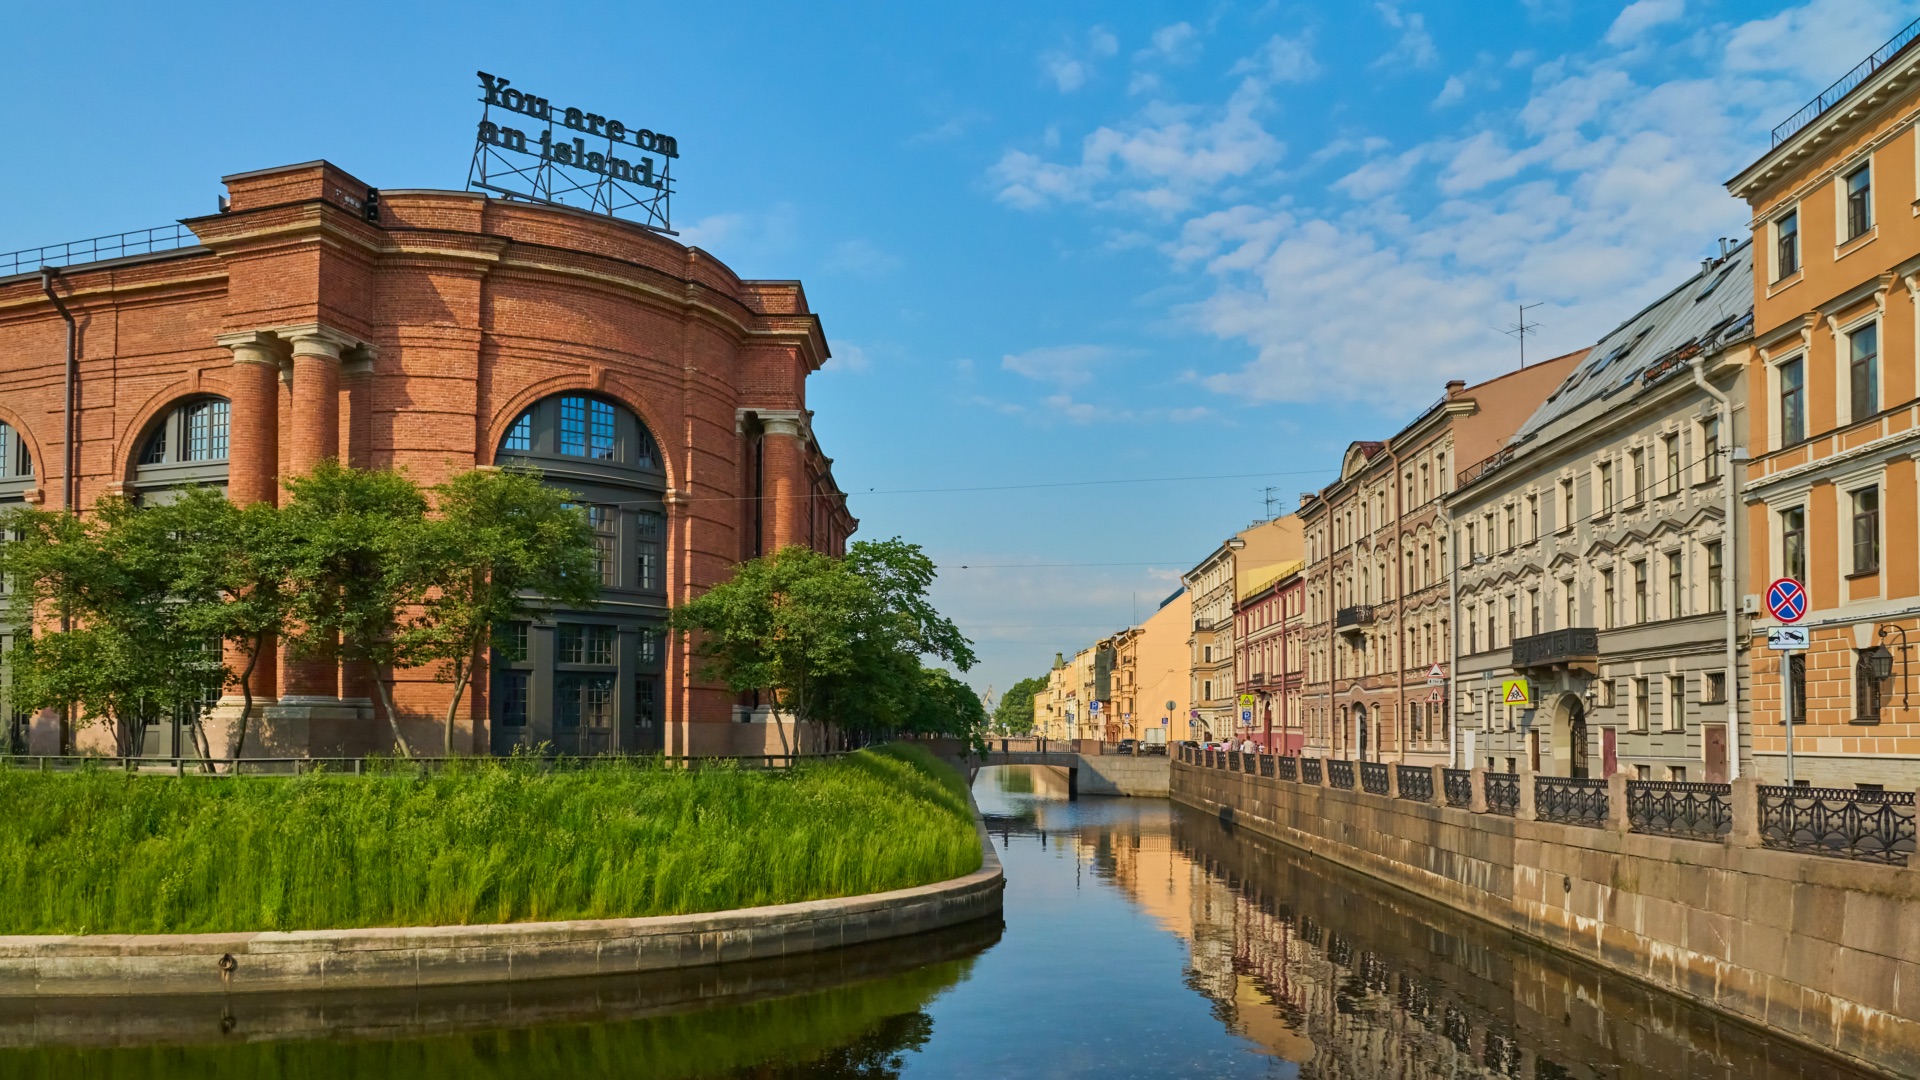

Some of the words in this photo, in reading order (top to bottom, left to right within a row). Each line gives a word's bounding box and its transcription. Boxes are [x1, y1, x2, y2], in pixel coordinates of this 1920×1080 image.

[477, 71, 549, 121] You
[564, 107, 626, 142] are
[636, 128, 680, 159] on
[478, 120, 528, 154] an
[540, 130, 664, 190] island.
